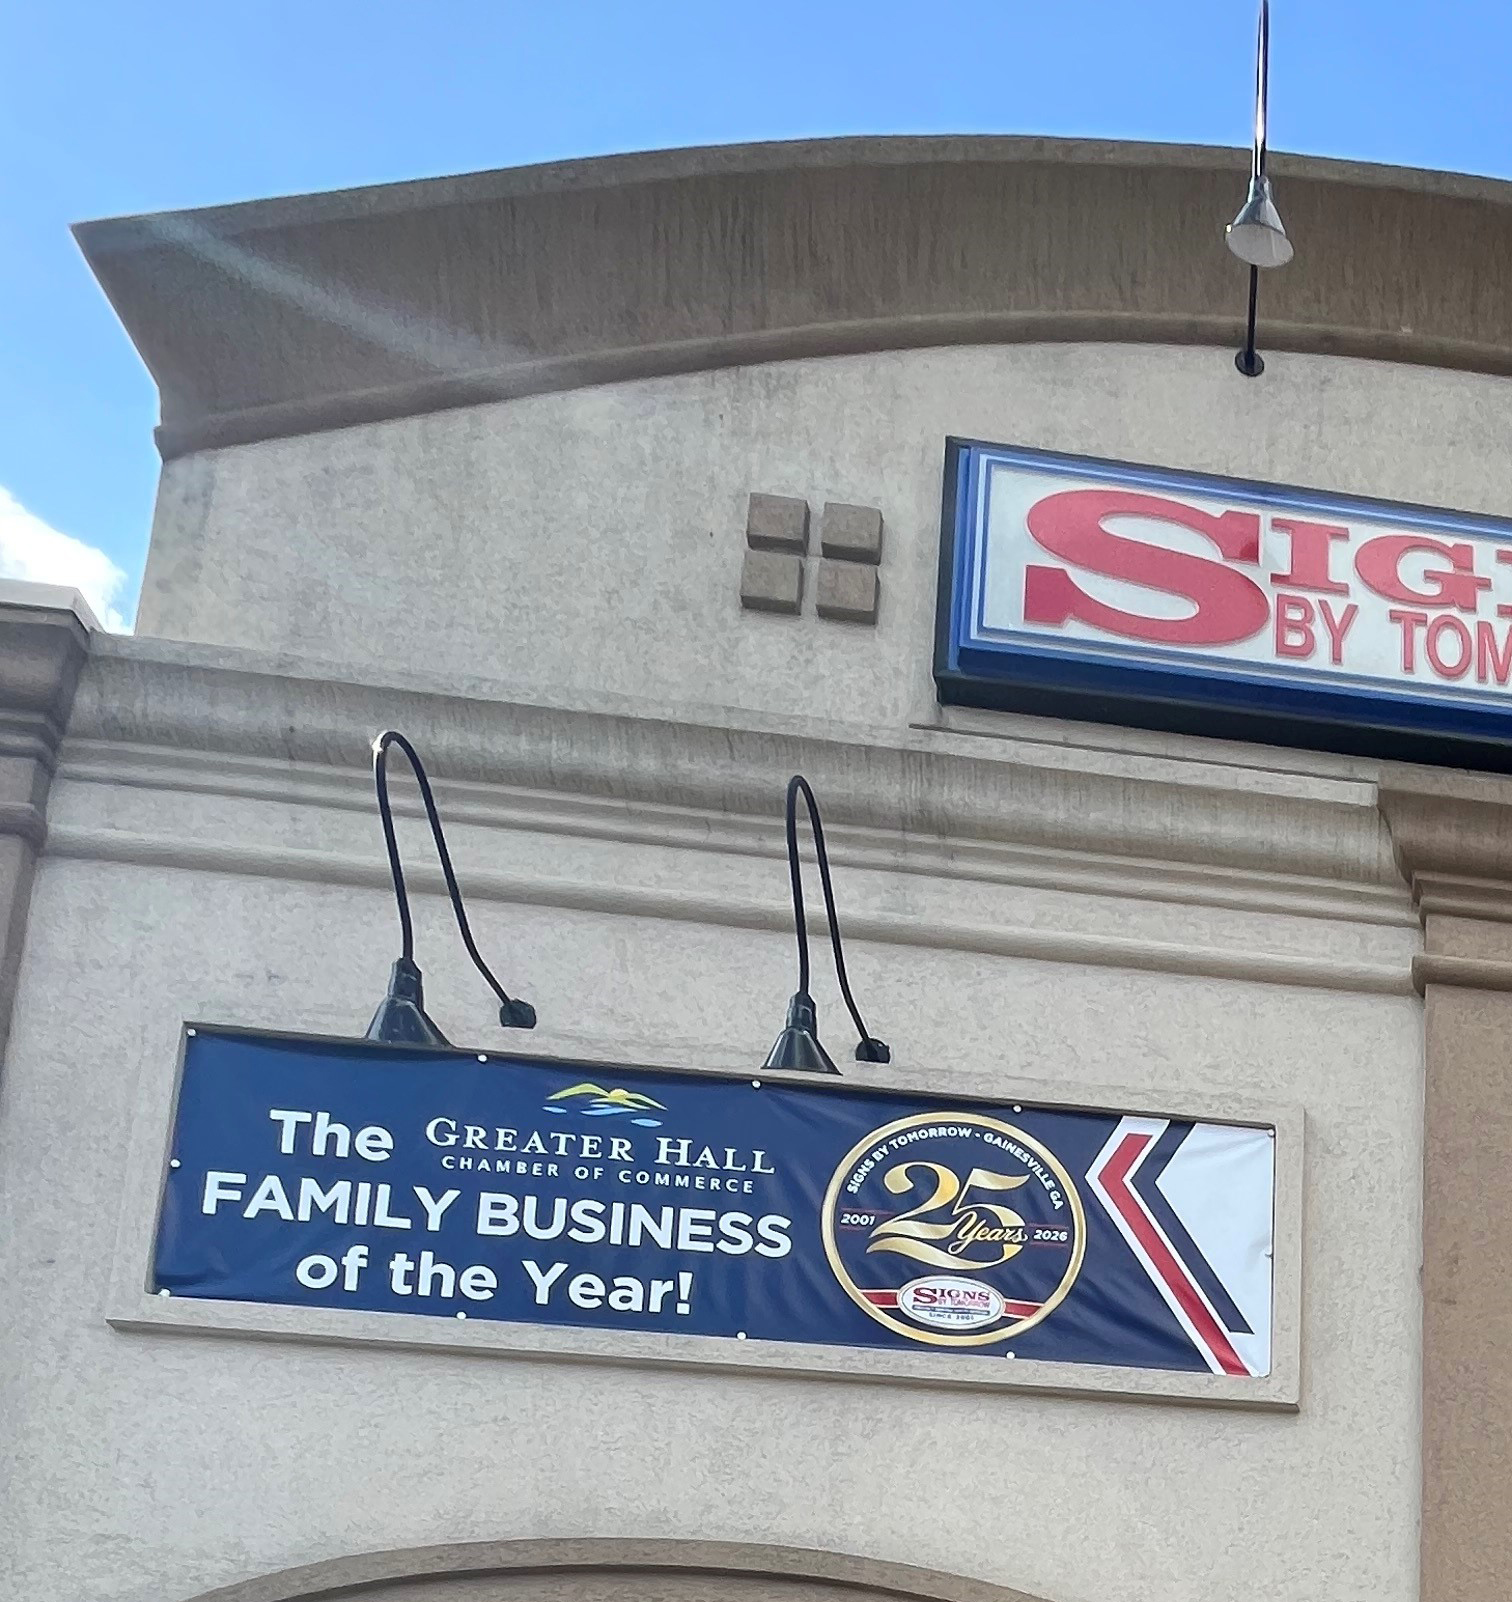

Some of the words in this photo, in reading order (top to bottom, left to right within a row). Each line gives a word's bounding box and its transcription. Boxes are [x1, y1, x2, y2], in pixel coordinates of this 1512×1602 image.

[1274, 593, 1359, 667] BY
[269, 1108, 394, 1162] The
[425, 1116, 634, 1162] GREATER
[655, 1136, 776, 1175] HALL
[441, 1155, 561, 1179] CHAMBER
[574, 1165, 605, 1180] OF
[619, 1169, 756, 1194] COMMERCE
[847, 1157, 876, 1195] SIGNS
[871, 1145, 891, 1163] BY
[888, 1126, 973, 1151] TOMORROW
[983, 1132, 1057, 1192] GAINESVILLE
[1049, 1190, 1065, 1210] GA
[201, 1170, 463, 1233] FAMILY
[476, 1192, 794, 1259] BUSINESS
[840, 1213, 876, 1227] 2001
[866, 1161, 1031, 1270] 25
[947, 1210, 1029, 1255] Years
[1032, 1228, 1069, 1242] 2026
[296, 1244, 368, 1292] of
[390, 1250, 499, 1302] the
[522, 1260, 694, 1315] Year!
[913, 1287, 990, 1305] SIGNS
